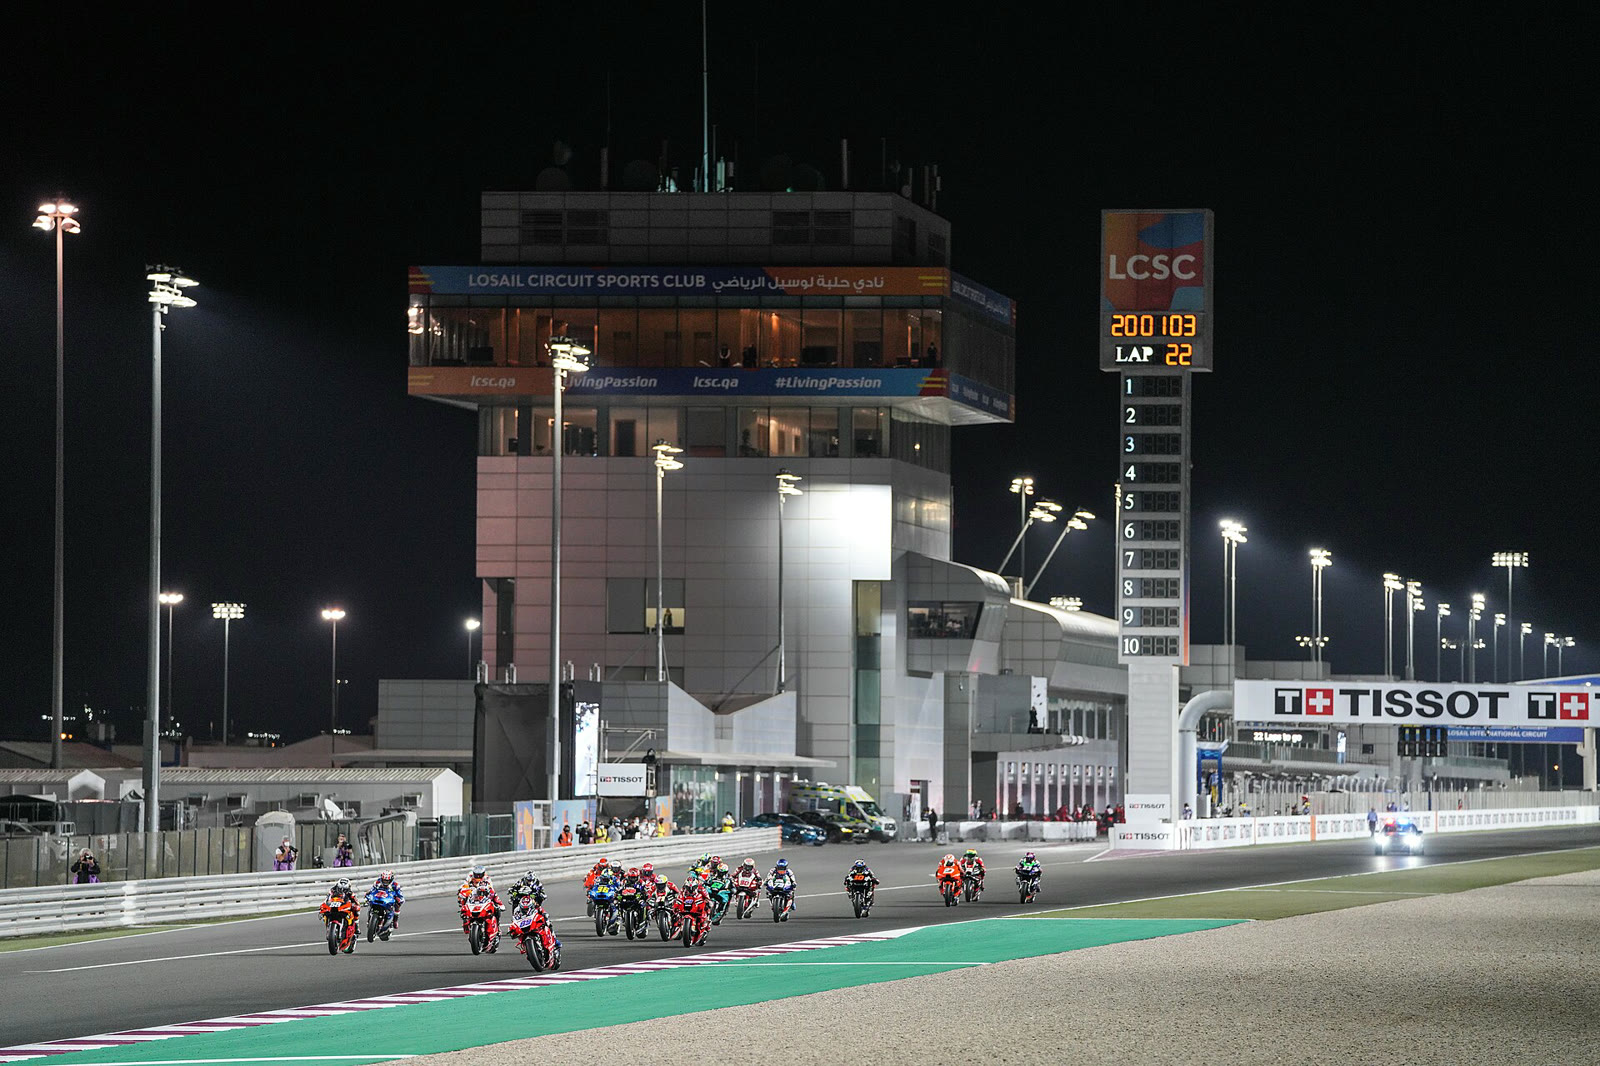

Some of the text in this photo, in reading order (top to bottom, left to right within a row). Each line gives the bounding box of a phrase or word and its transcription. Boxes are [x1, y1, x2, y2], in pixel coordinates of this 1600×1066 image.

[1109, 254, 1196, 280] LCSC
[469, 274, 706, 287] LOSAIL CIRCUIT SPORTS CLUB
[712, 275, 884, 293] نادي حلبة لوسيل الرياضي
[1115, 343, 1193, 366] LAP 22
[471, 375, 516, 388] lcsc.qa
[551, 376, 657, 390] LivingPassion
[693, 376, 739, 390] lcsc.qa
[775, 377, 882, 390] #LivingPassion
[1125, 379, 1132, 394] 1
[1126, 408, 1136, 423] 2
[1125, 437, 1135, 452] 3
[1125, 466, 1136, 481] 4
[1125, 494, 1134, 510] 5
[1125, 523, 1135, 539] 6
[1125, 552, 1135, 567] 7
[1124, 580, 1134, 596] 8
[1124, 608, 1134, 625] 9
[1123, 638, 1139, 655] 10
[1339, 688, 1510, 719] TISSOT
[1134, 832, 1169, 840] TISSOT
